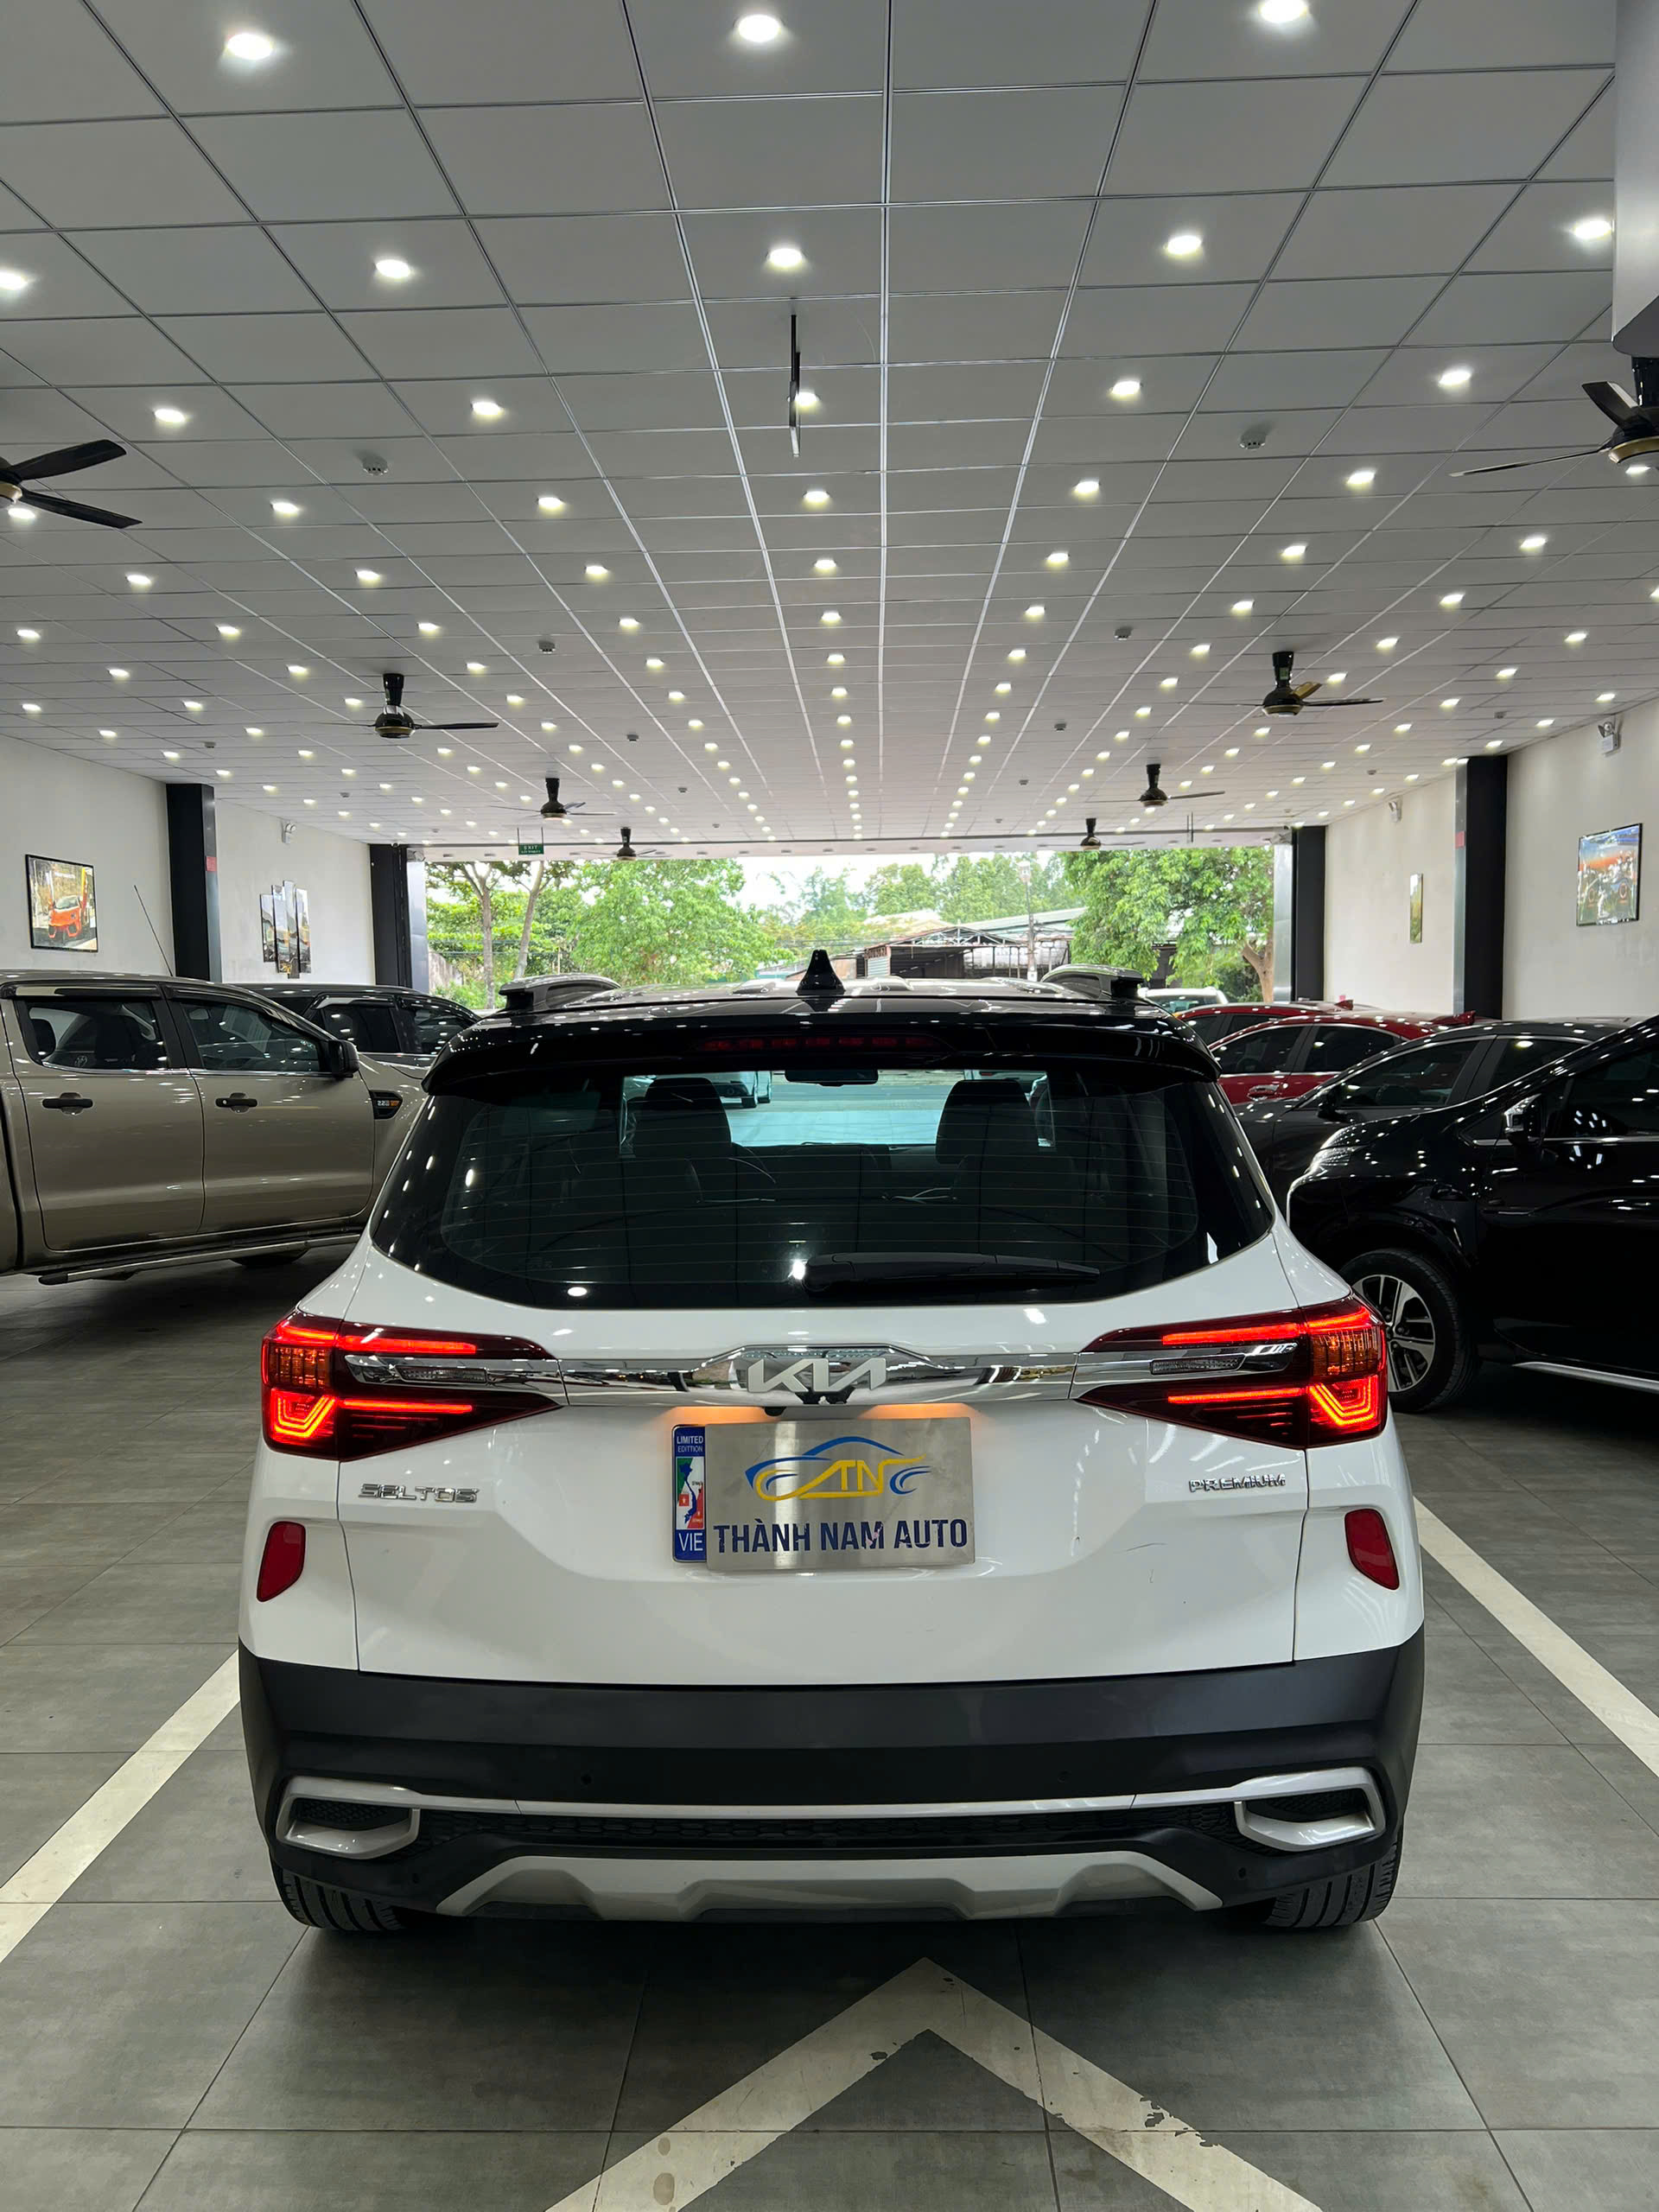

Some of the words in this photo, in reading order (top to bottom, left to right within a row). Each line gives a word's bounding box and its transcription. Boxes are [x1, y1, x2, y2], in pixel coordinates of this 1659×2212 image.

[747, 1357, 887, 1393] KIA
[677, 1435, 704, 1444] LIMITED
[1189, 1472, 1286, 1492] PREMIUM
[358, 1483, 480, 1503] SELTOS
[678, 1533, 703, 1551] VIE
[713, 1518, 810, 1554] THÀNH
[820, 1521, 885, 1551] NAM
[893, 1518, 968, 1549] AUTO
